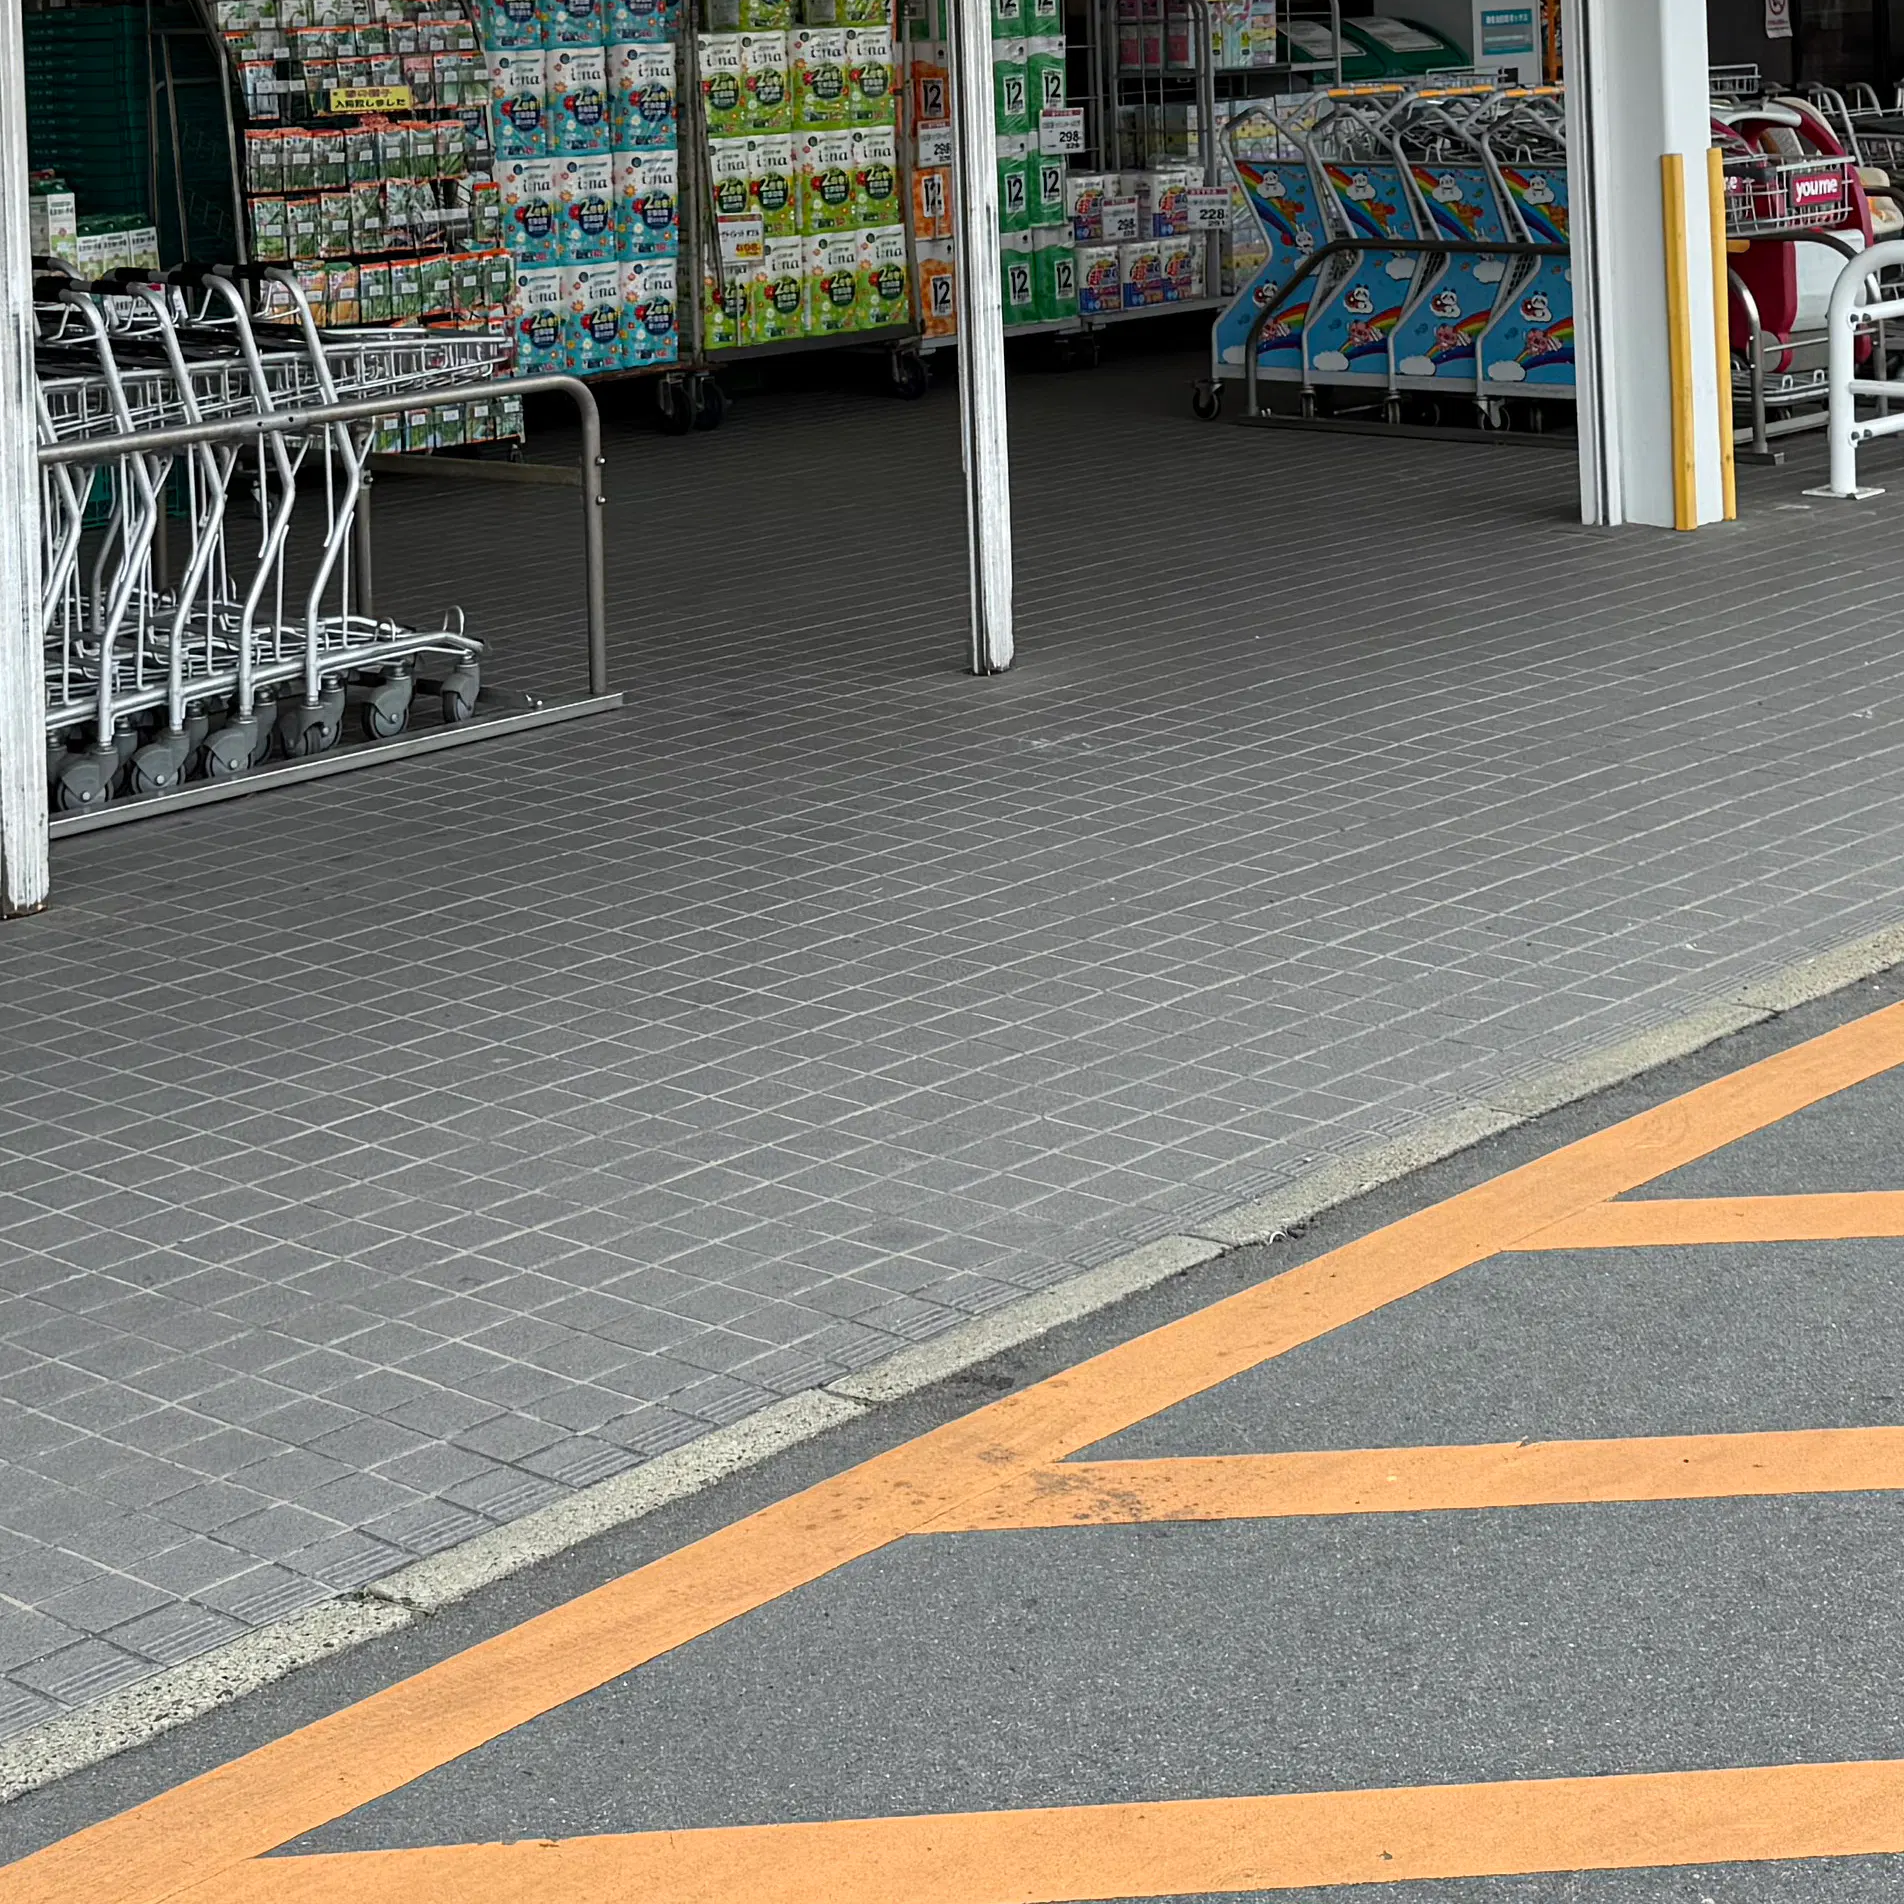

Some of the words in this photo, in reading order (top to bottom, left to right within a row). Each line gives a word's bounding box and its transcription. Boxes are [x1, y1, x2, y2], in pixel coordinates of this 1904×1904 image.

[923, 84, 942, 113] 12
[1006, 81, 1023, 110] 12
[1045, 76, 1062, 104] 12
[1059, 131, 1079, 143] 298
[1008, 178, 1024, 207] 12
[1043, 170, 1060, 198] 12
[1795, 178, 1838, 201] youme
[1200, 209, 1225, 219] 228
[1013, 270, 1029, 300] 12
[1058, 264, 1073, 293] 12
[933, 281, 951, 310] 12
